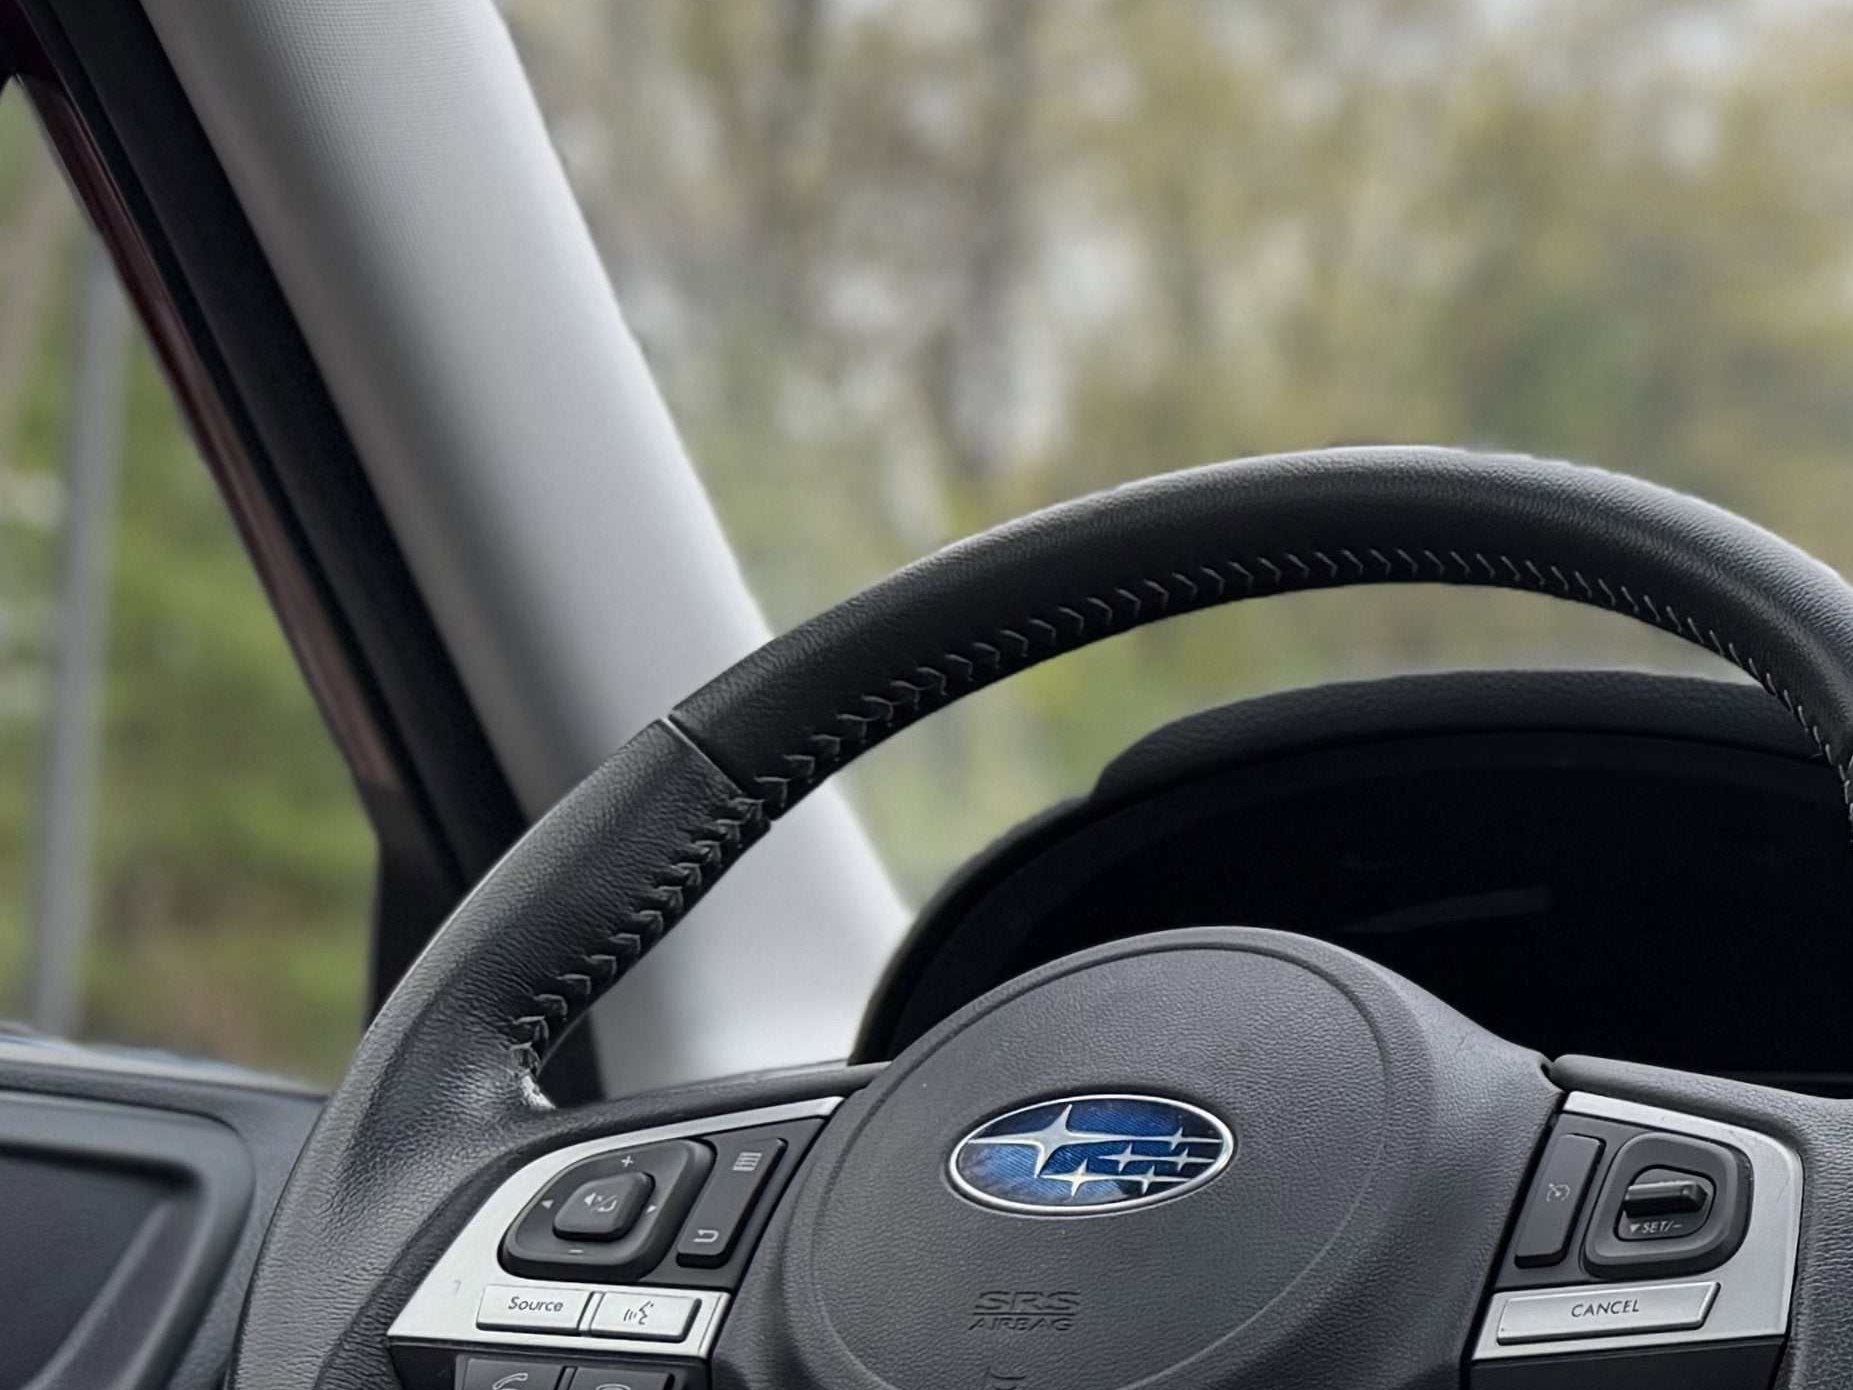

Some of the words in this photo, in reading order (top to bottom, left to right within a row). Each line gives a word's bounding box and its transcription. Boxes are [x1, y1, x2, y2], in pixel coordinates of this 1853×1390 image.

[508, 1296, 564, 1312] Source
[974, 1291, 1081, 1310] SRS
[1571, 1299, 1640, 1317] CANCEL
[968, 1317, 1074, 1332] AIRBAG
